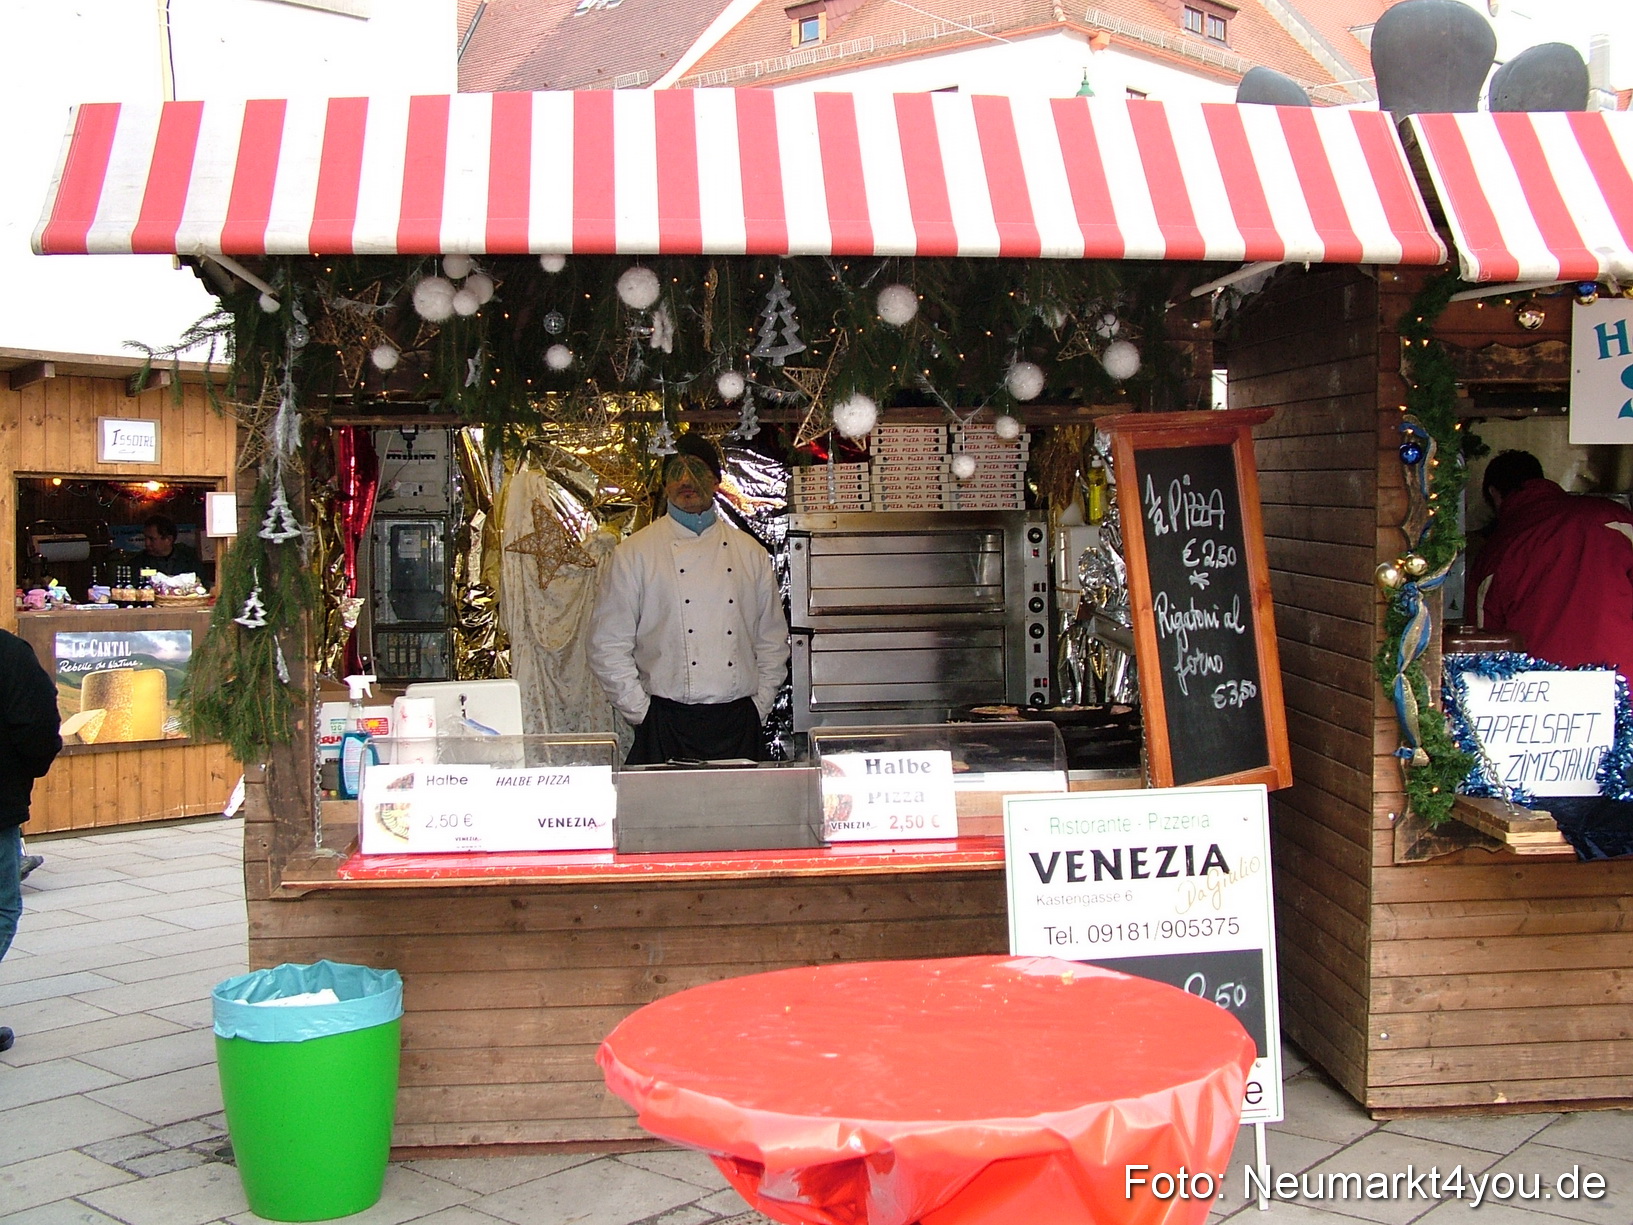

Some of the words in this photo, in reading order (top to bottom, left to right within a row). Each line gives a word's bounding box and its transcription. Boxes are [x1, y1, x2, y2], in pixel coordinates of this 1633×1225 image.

[1154, 591, 1220, 642] Rigatoni
[1224, 594, 1245, 634] al
[1474, 712, 1602, 744] APFELSAFT
[865, 758, 932, 775] Halbe
[1504, 745, 1610, 782] ZIMTSTANG
[426, 774, 468, 786] Halbe
[496, 776, 532, 787] HALBE
[536, 774, 570, 786] PIZZA
[868, 791, 925, 804] Pizza
[425, 814, 458, 829] 2,50
[463, 812, 473, 828] €
[538, 817, 597, 828] VENEZIA
[830, 820, 871, 830] VENEZIA
[890, 814, 924, 832] 2,50
[1050, 815, 1132, 836] Ristorante
[1148, 811, 1210, 831] Pizzeria
[1028, 843, 1230, 884] VENEZIA
[1036, 892, 1121, 908] Kastengasse
[1124, 890, 1134, 902] 6
[1044, 926, 1079, 946] Tel.
[1088, 916, 1240, 944] 09181/905375
